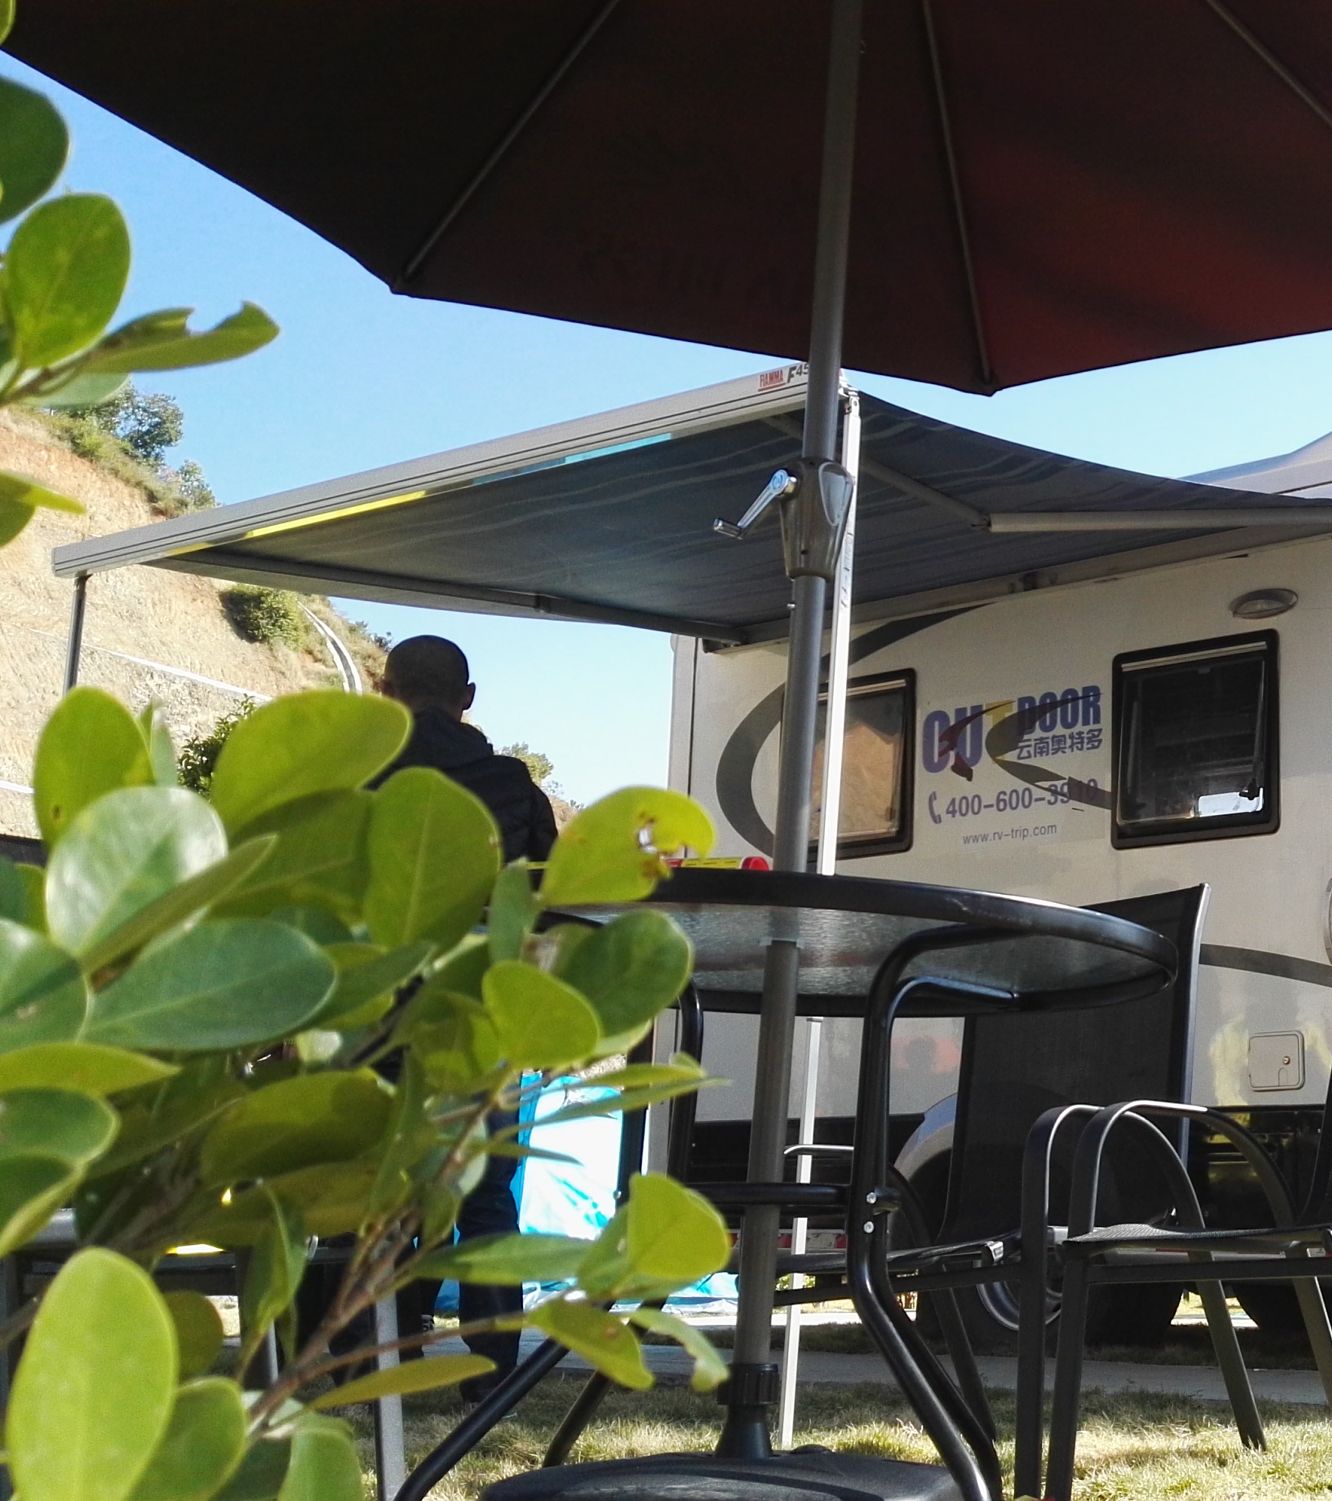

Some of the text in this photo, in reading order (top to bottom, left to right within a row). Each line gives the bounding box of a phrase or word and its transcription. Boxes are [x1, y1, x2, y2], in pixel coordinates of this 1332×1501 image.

[759, 369, 784, 388] FIAMMA
[1017, 728, 1103, 761] 云南奥特多
[962, 823, 1058, 846] www.rv-trip.com
